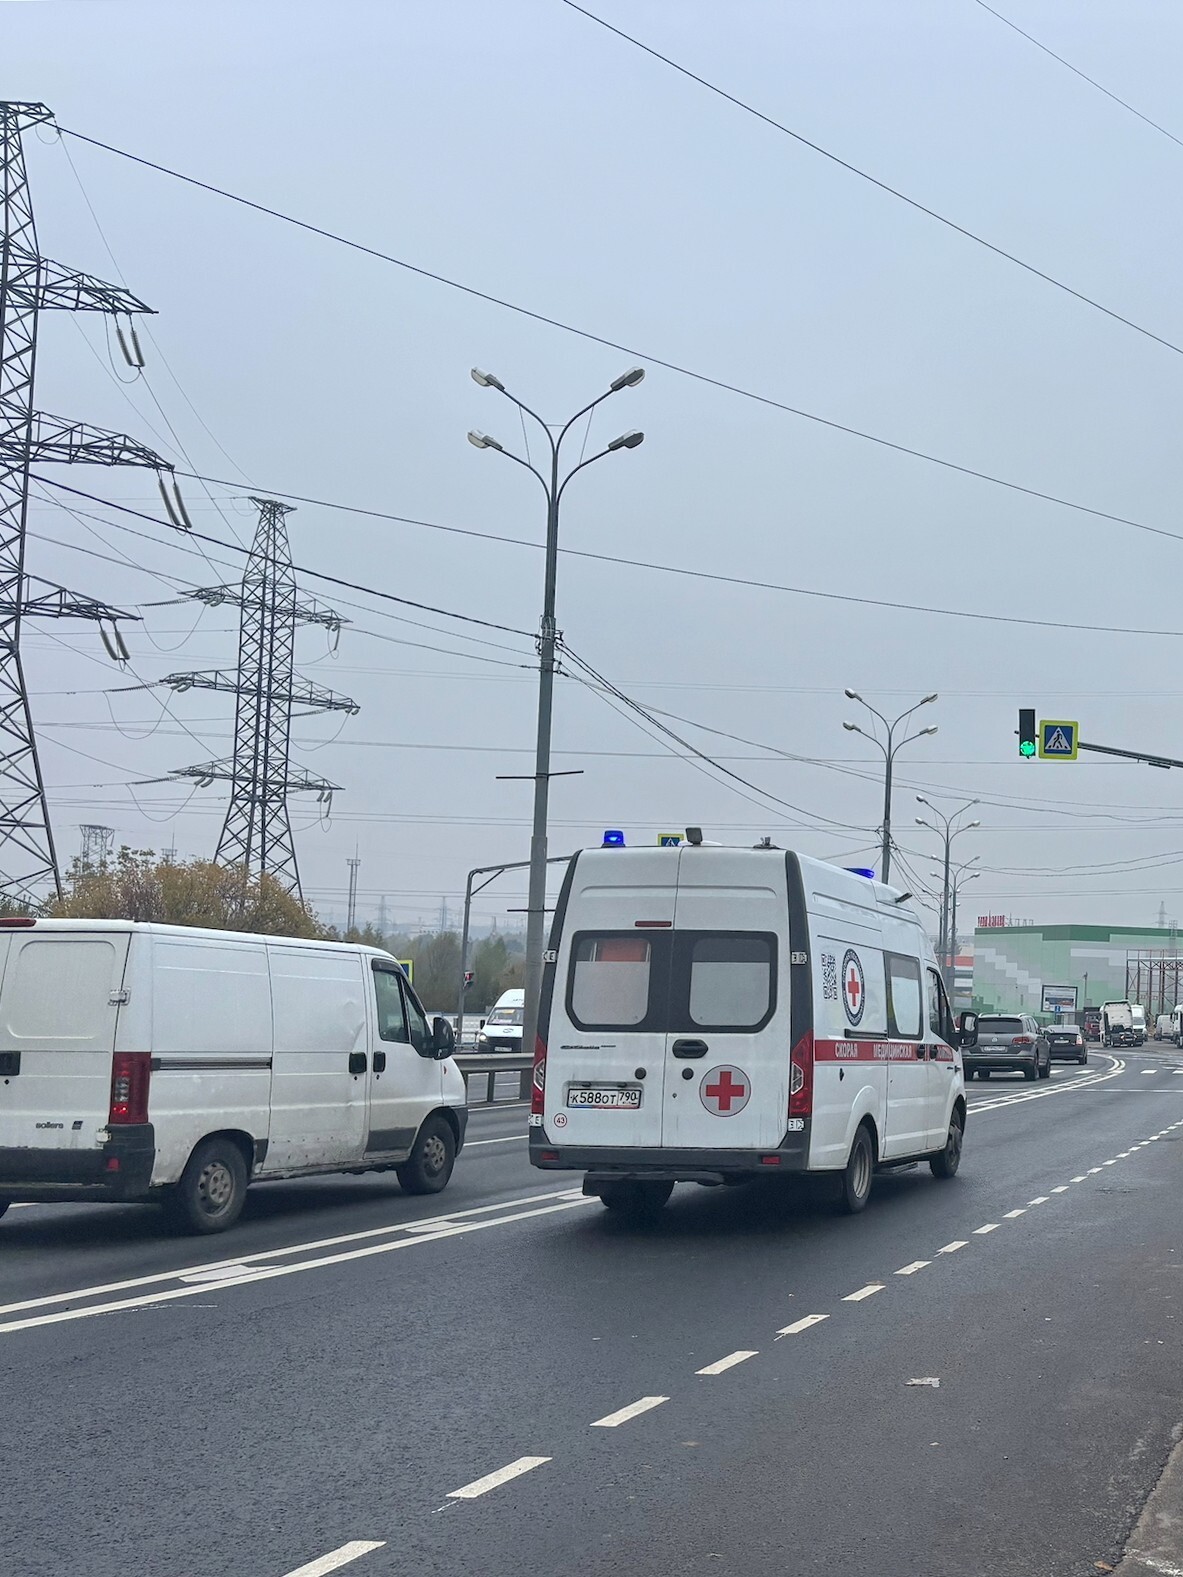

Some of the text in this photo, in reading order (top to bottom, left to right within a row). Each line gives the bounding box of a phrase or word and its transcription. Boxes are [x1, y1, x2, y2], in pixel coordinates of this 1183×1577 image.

[835, 1043, 859, 1058] СКОРАЯ
[873, 1044, 913, 1060] МЕДИЦИНСКАЯ
[572, 1092, 637, 1104] К588ОТ 790
[35, 1121, 64, 1129] sollers
